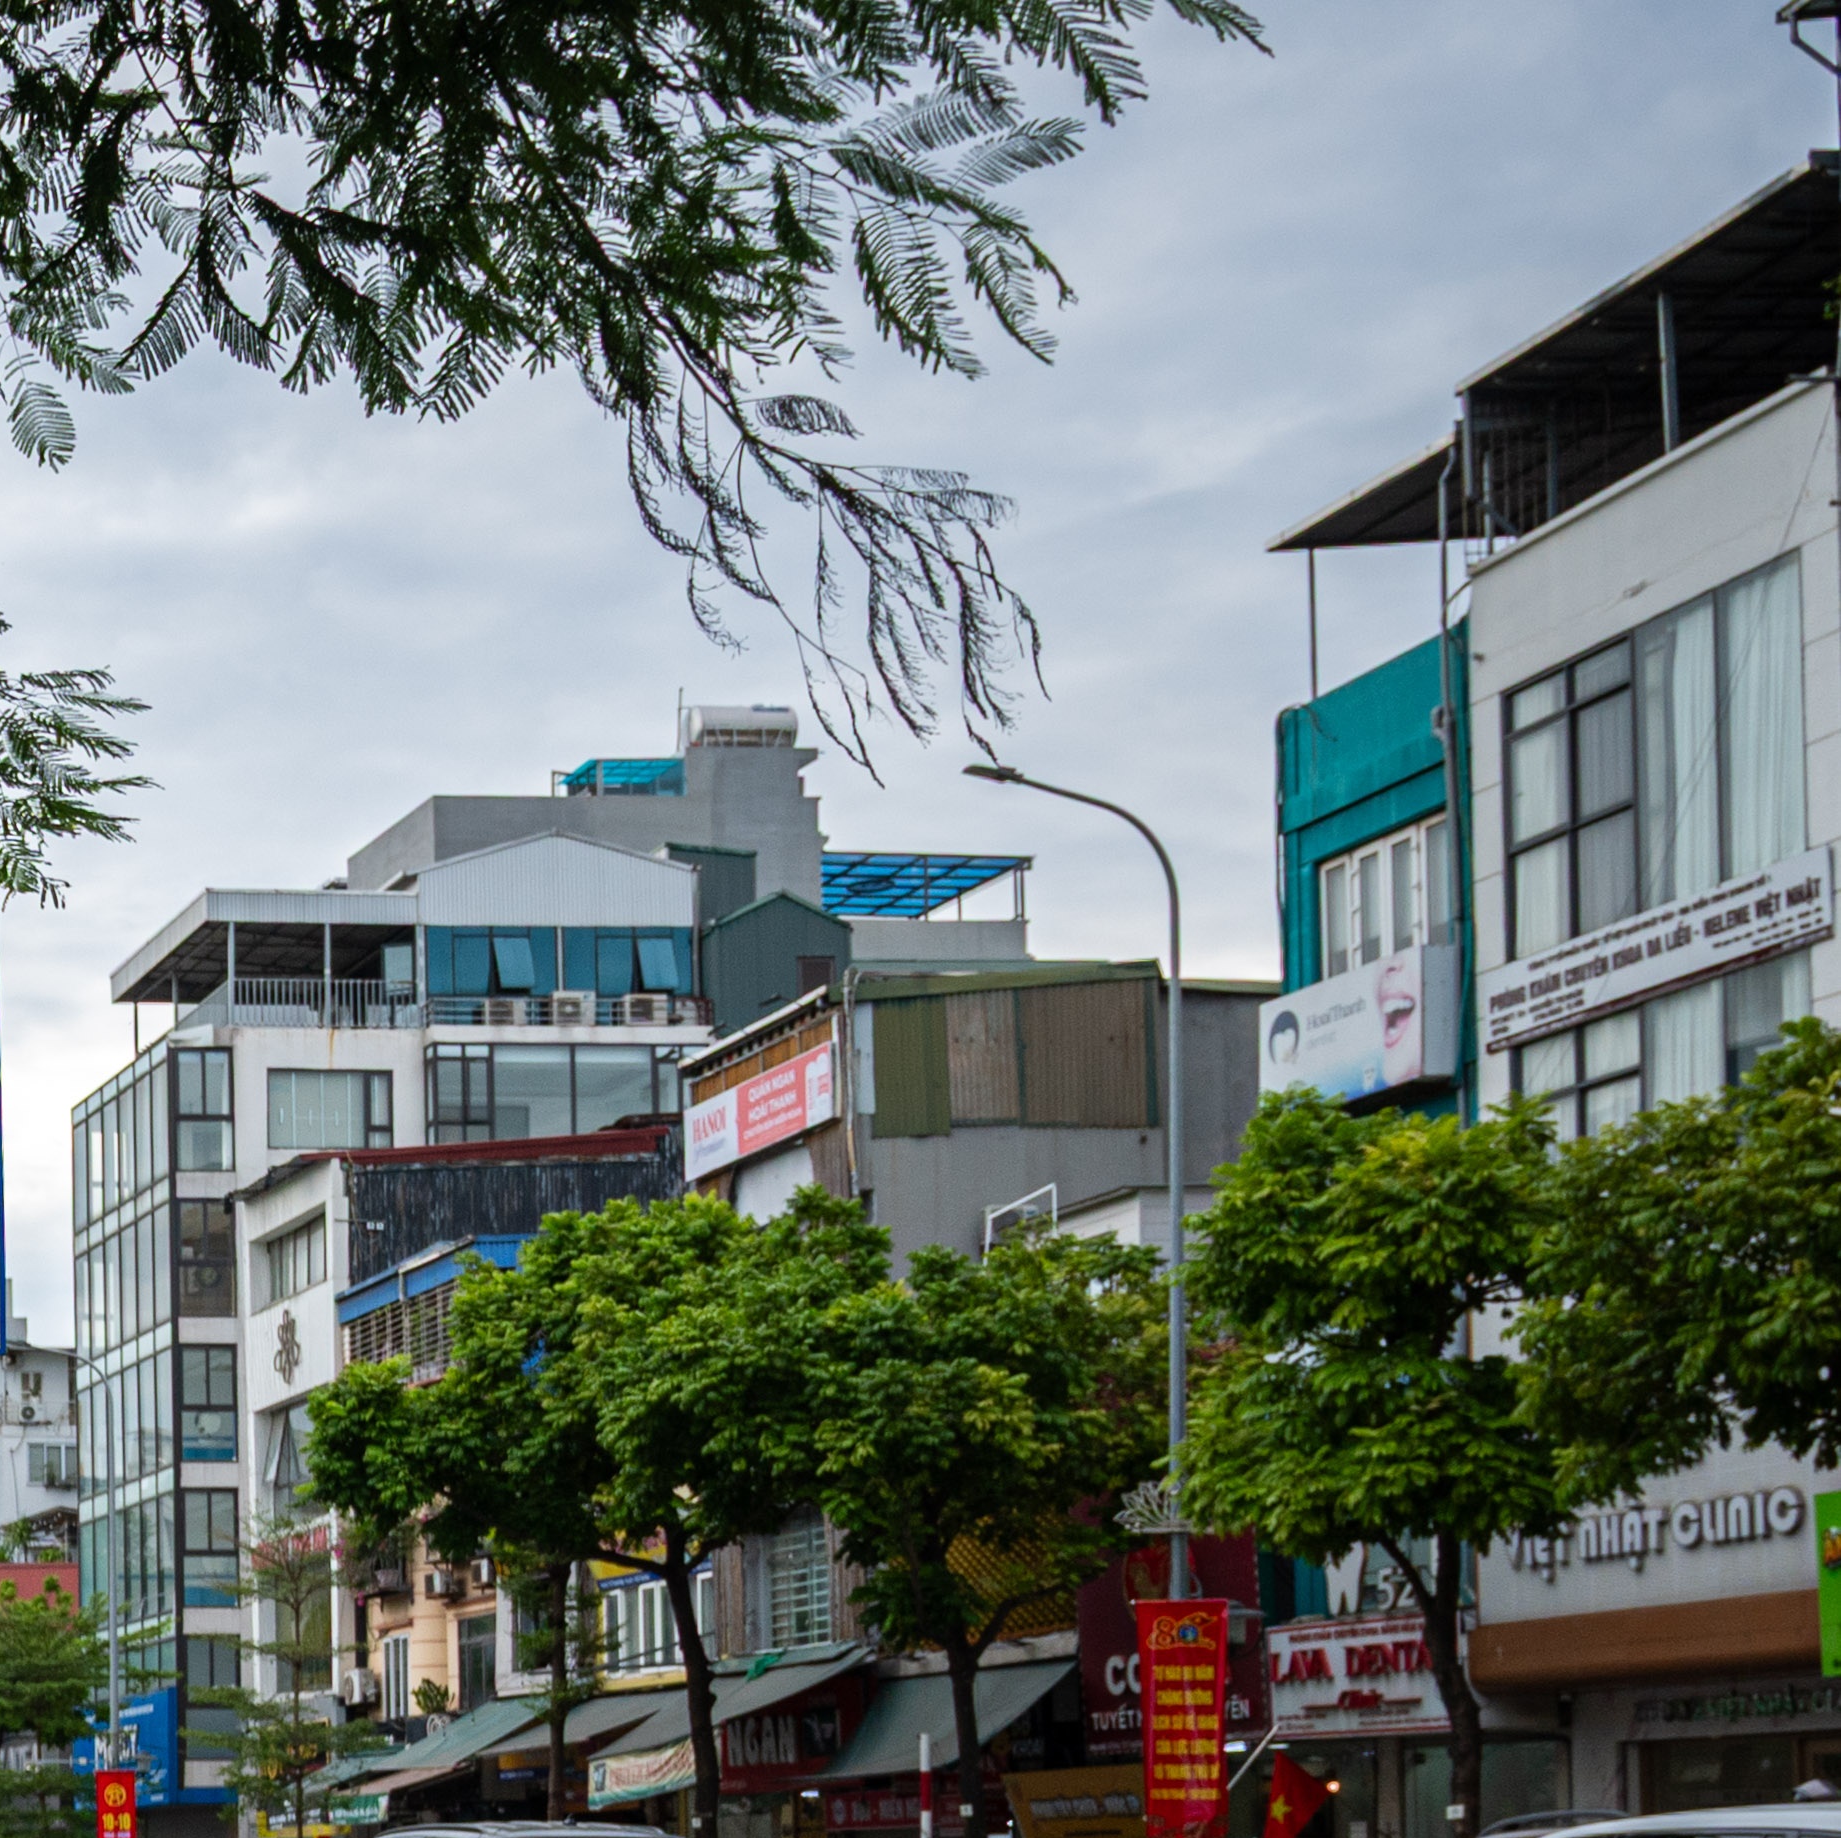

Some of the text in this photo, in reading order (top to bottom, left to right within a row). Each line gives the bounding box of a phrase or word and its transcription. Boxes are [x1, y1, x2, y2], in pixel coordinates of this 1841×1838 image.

[692, 1105, 727, 1145] HANOI
[1672, 1487, 1807, 1550] CLINIC
[1345, 1639, 1435, 1677] DENTA
[1091, 1702, 1134, 1731] TUYẾT
